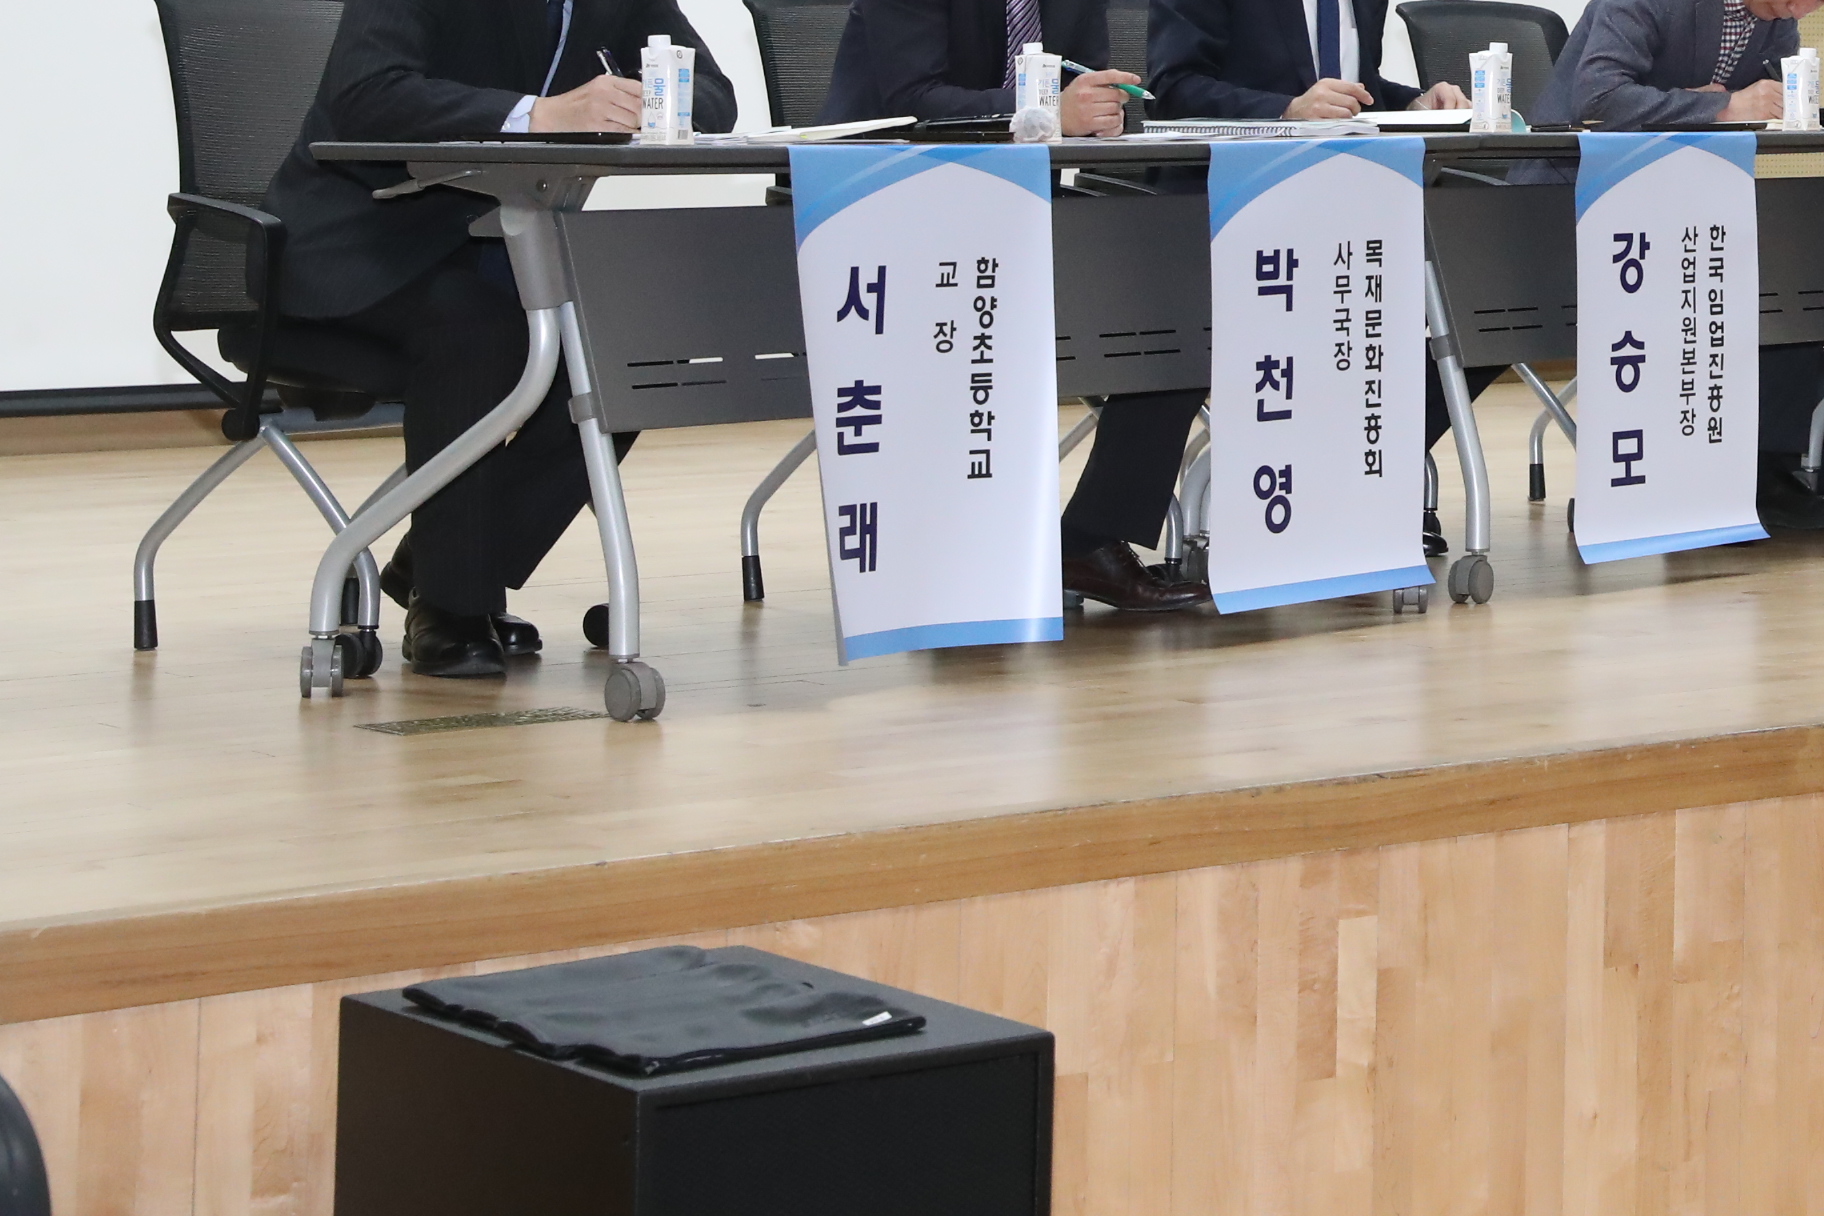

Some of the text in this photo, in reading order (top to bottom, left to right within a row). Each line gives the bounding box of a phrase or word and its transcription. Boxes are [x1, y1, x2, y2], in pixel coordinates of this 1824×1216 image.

[932, 262, 958, 353] 교장
[966, 257, 999, 479] 함양초등학교
[1253, 249, 1299, 534] 박천영
[1333, 240, 1353, 371] 사무국장
[1363, 239, 1384, 478] 목재문화진흥회
[1611, 232, 1650, 487] 강승모
[1679, 226, 1699, 437] 산업지원본부장
[1707, 224, 1726, 444] 한국임업진흥원
[836, 265, 887, 574] 서춘래
